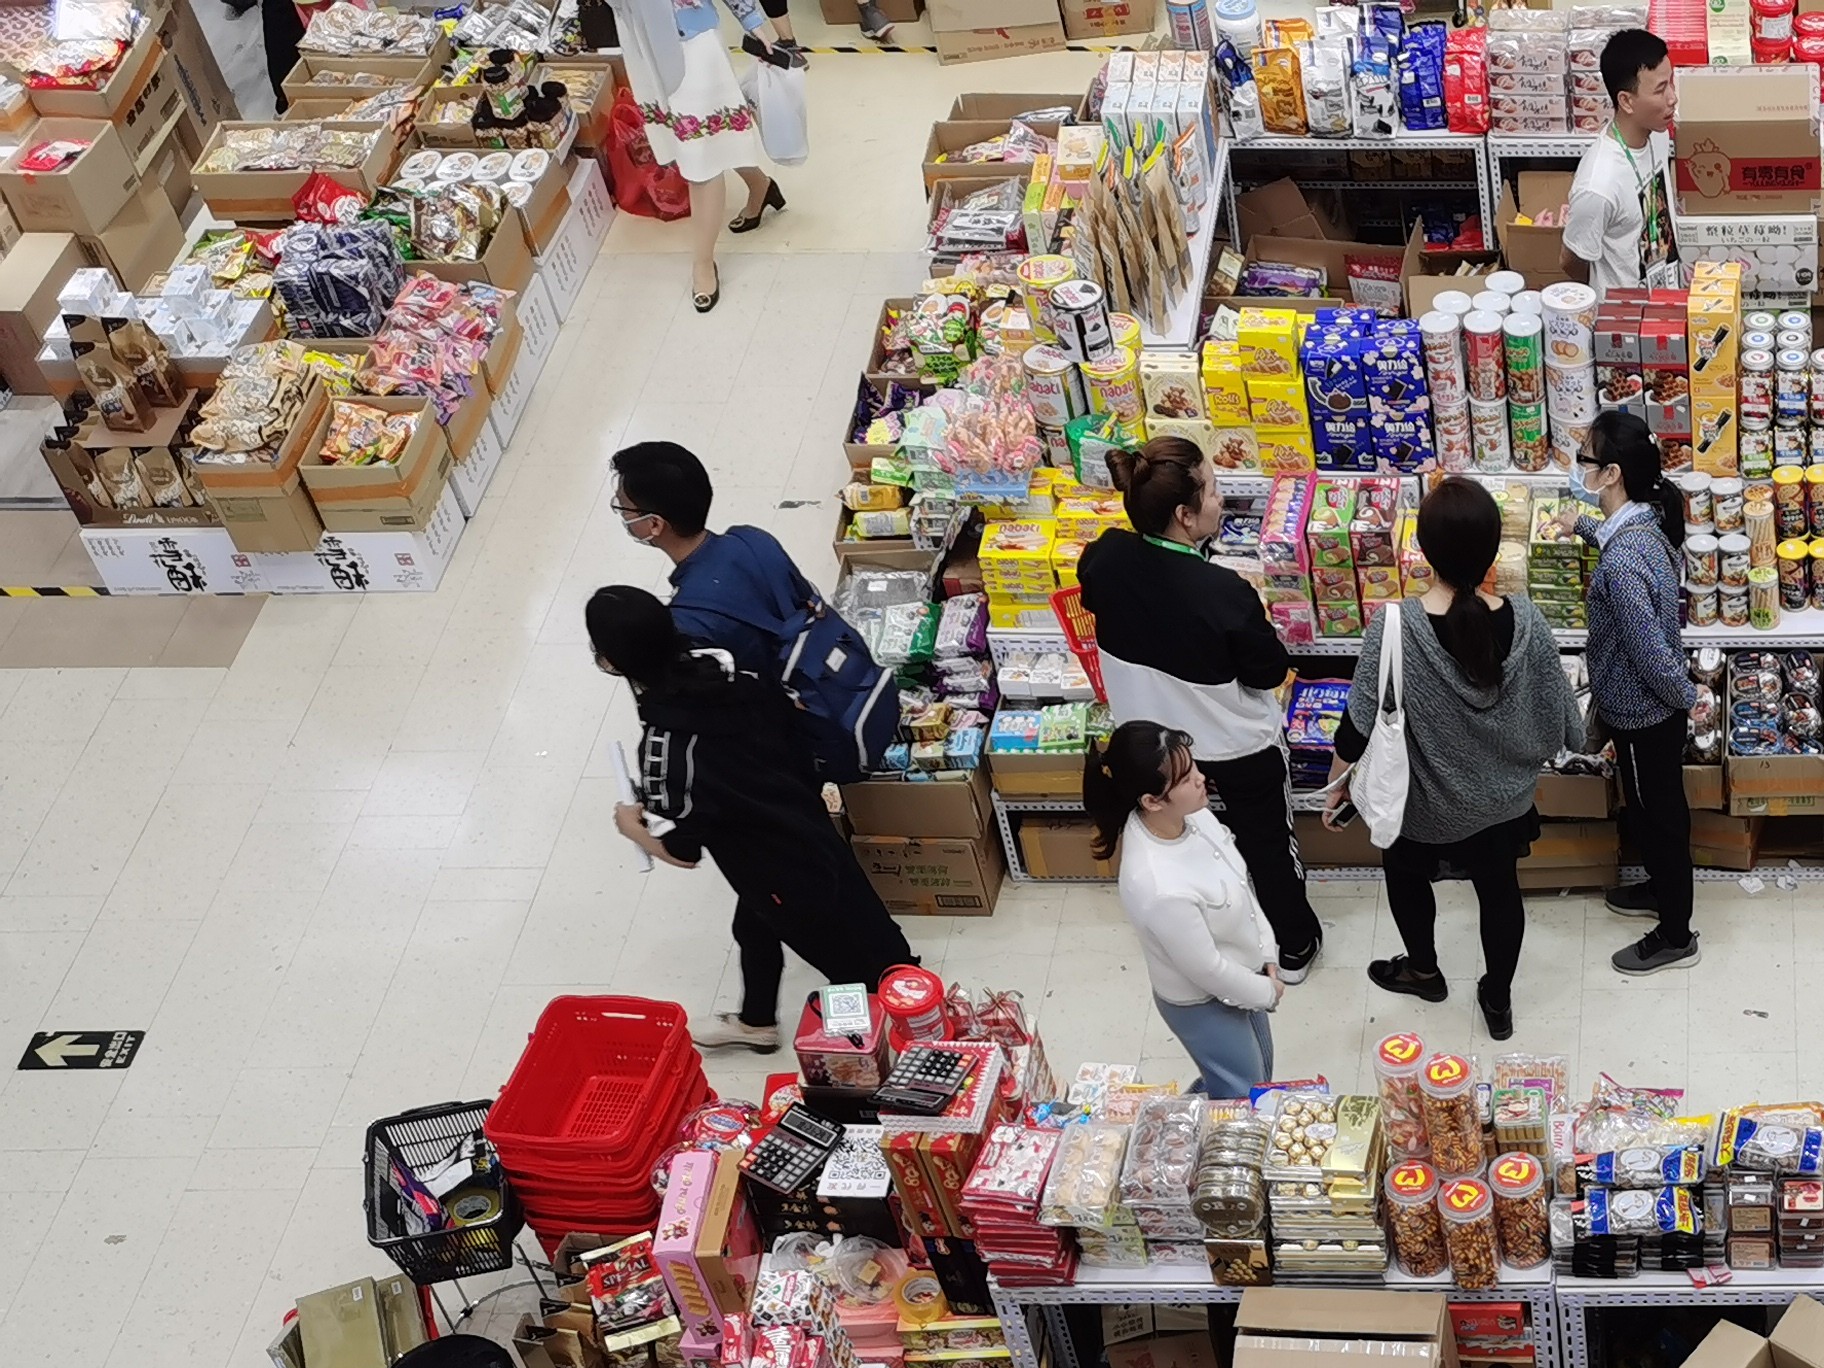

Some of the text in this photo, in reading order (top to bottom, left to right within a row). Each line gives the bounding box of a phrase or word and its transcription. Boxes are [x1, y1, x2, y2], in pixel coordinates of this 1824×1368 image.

[1100, 379, 1137, 398] nabati
[999, 522, 1041, 535] nabati
[115, 1033, 136, 1064] EXIT
[602, 1258, 651, 1289] SPEIAL
